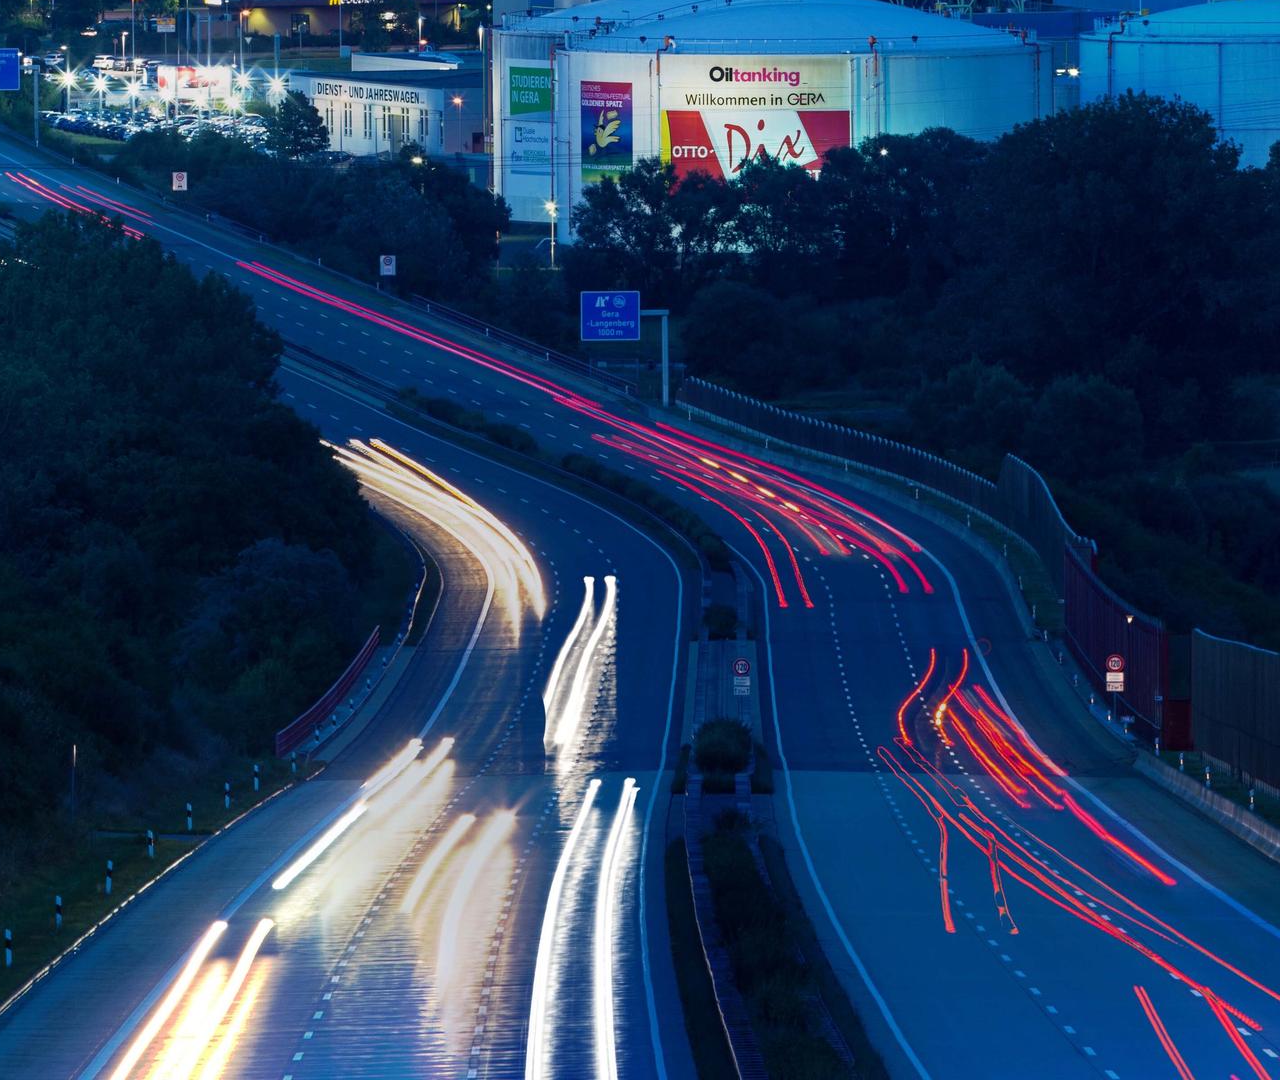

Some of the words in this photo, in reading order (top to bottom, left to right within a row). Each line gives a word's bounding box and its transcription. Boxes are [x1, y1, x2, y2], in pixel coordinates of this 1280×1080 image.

[511, 74, 552, 89] STUDIEREN
[709, 66, 800, 87] Oiltanking
[317, 82, 342, 97] DIENST
[348, 85, 364, 99] UND
[365, 87, 420, 105] JAHRESWAGEN
[511, 90, 519, 103] IN
[519, 91, 540, 104] GERA
[685, 93, 766, 106] Willkommen
[770, 93, 783, 106] in
[787, 92, 825, 106] GERA
[606, 100, 623, 108] SPATZ
[601, 310, 620, 318] Gera
[598, 328, 615, 336] 1000
